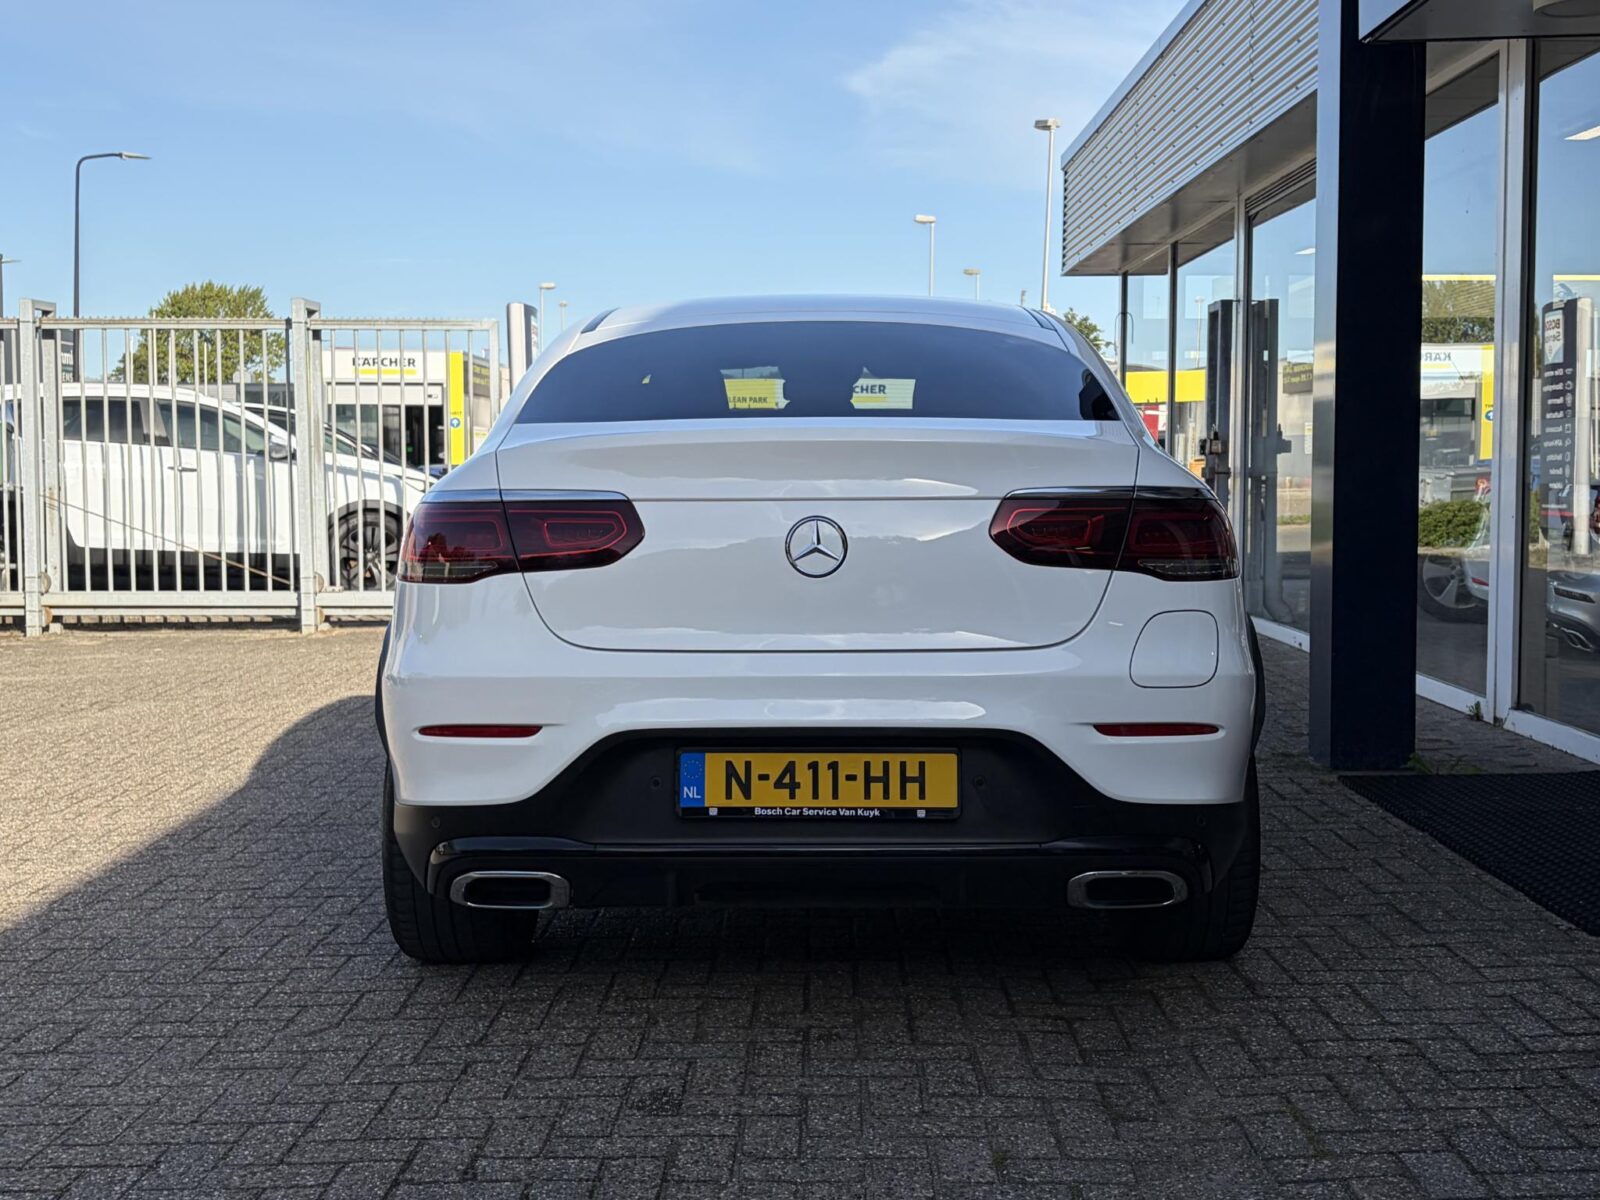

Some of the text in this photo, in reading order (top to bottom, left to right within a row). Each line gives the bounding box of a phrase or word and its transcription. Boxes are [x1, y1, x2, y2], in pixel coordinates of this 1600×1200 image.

[749, 396, 768, 404] PARK
[725, 760, 926, 800] N-411-HH
[683, 786, 702, 799] NL
[754, 807, 881, 818] Bosch Car Service Van Kuyk
